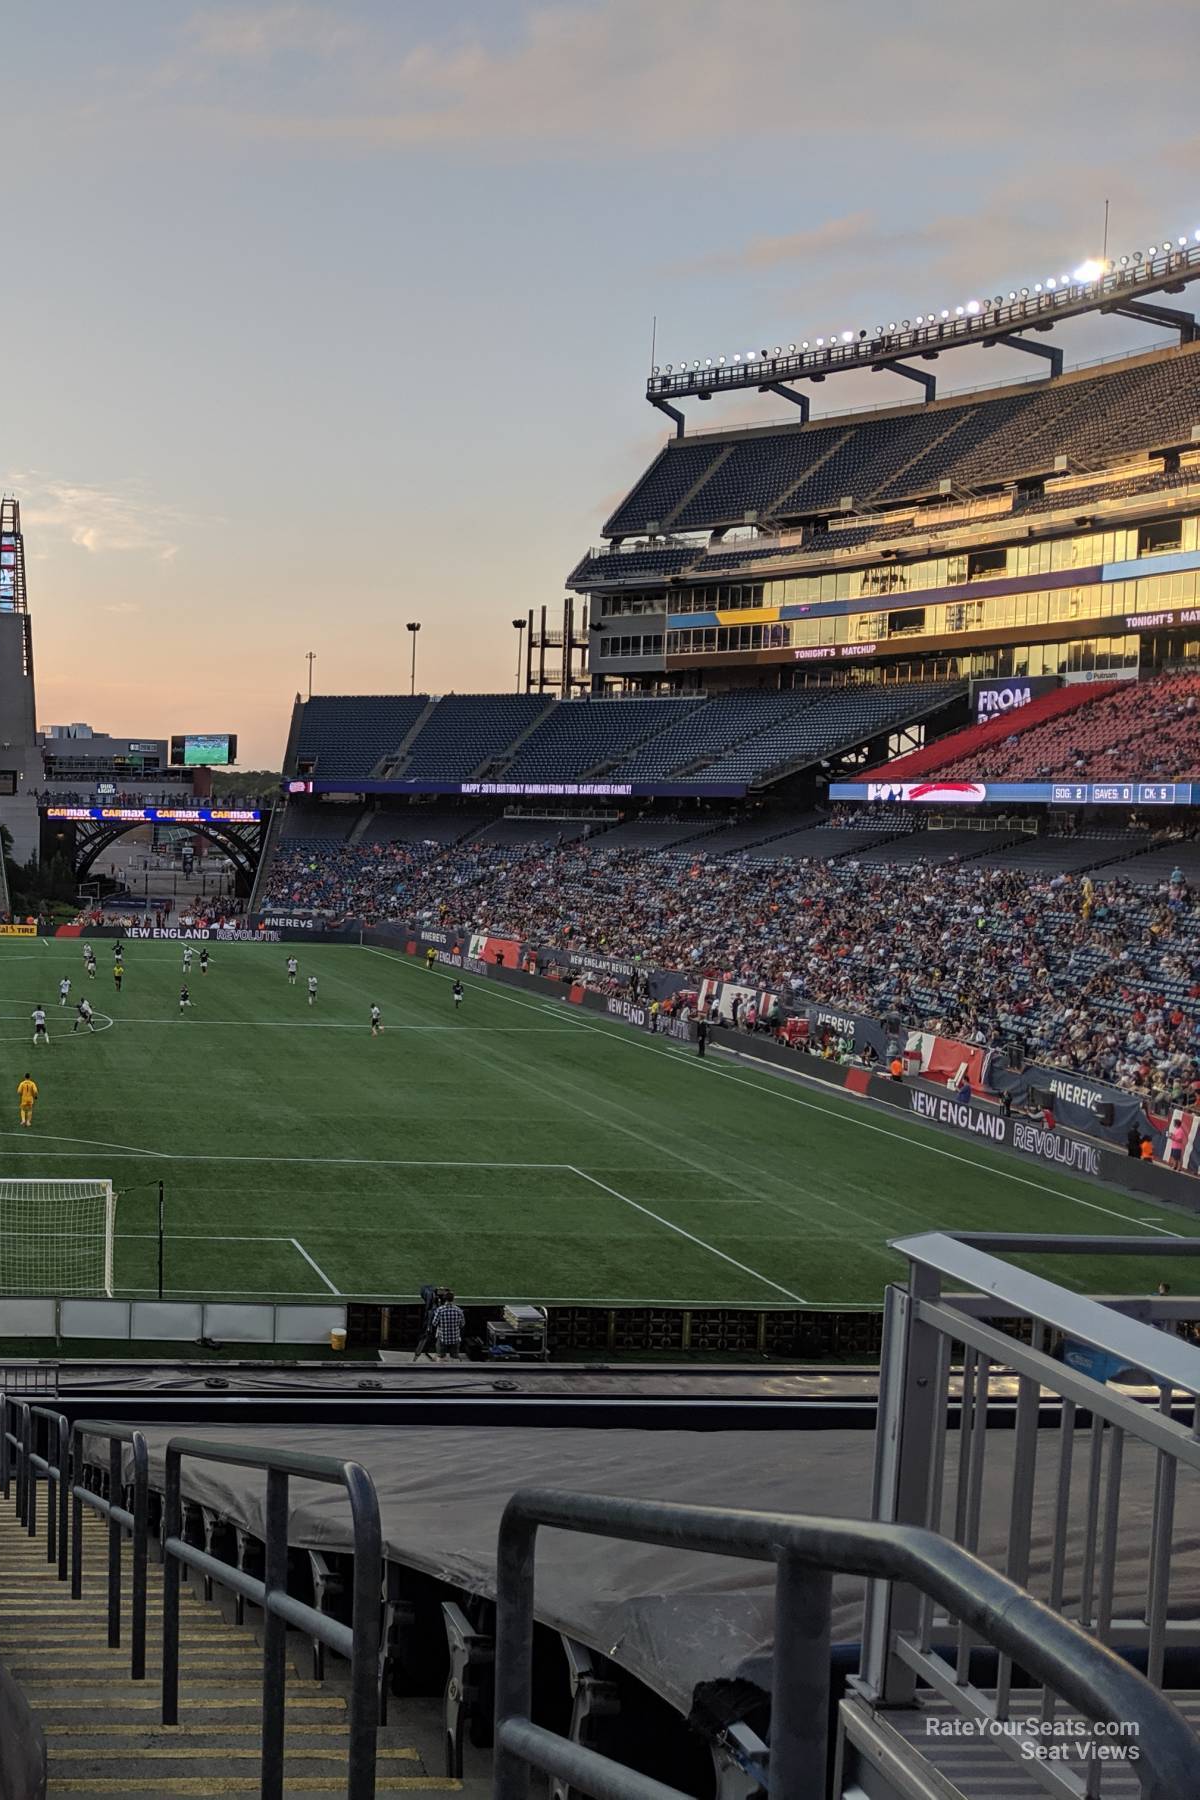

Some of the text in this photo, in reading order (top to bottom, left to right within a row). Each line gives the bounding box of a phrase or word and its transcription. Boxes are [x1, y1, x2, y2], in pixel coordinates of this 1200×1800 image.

[1126, 613, 1173, 628] TONIGHT'S
[795, 644, 876, 659] TONIGHT'S MATCHUP
[1093, 671, 1118, 680] Putnam
[978, 688, 1031, 711] FROM
[1055, 788, 1082, 799] SOG: 2
[1094, 788, 1130, 800] SAVES: 0
[1144, 788, 1167, 799] CK: 5
[265, 918, 313, 929] #NEREVS
[17, 926, 35, 934] TIRE
[153, 928, 210, 940] ENGLAND
[570, 954, 583, 965] NEW
[584, 956, 611, 970] ENGLAND
[816, 1013, 855, 1035] NEREVS
[911, 1089, 938, 1117] NEW
[939, 1101, 1006, 1141] ENGLAND
